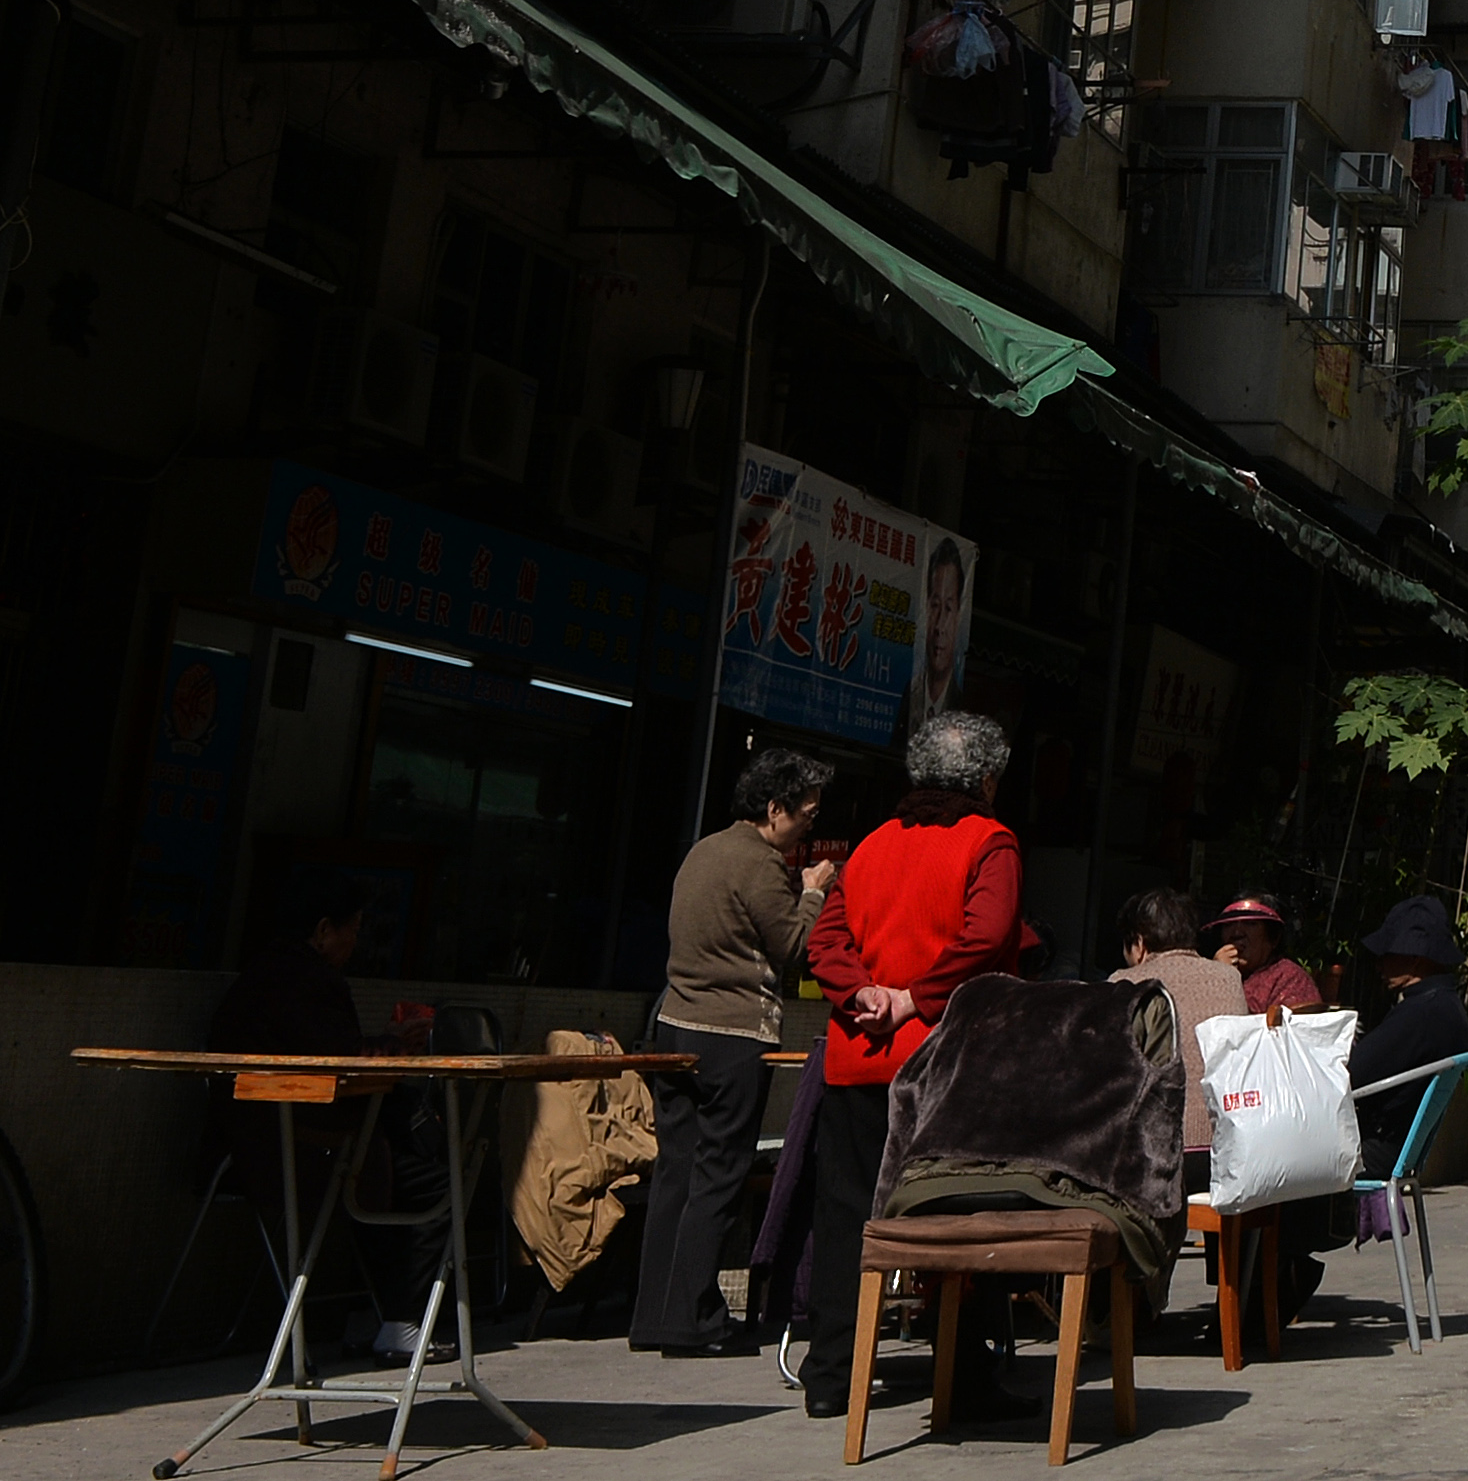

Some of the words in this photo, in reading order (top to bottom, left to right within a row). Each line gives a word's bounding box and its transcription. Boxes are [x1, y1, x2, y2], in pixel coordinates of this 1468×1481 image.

[356, 572, 453, 627] SUPER
[469, 605, 534, 647] MAID
[724, 516, 867, 672] 黃建彬
[863, 649, 893, 684] MH
